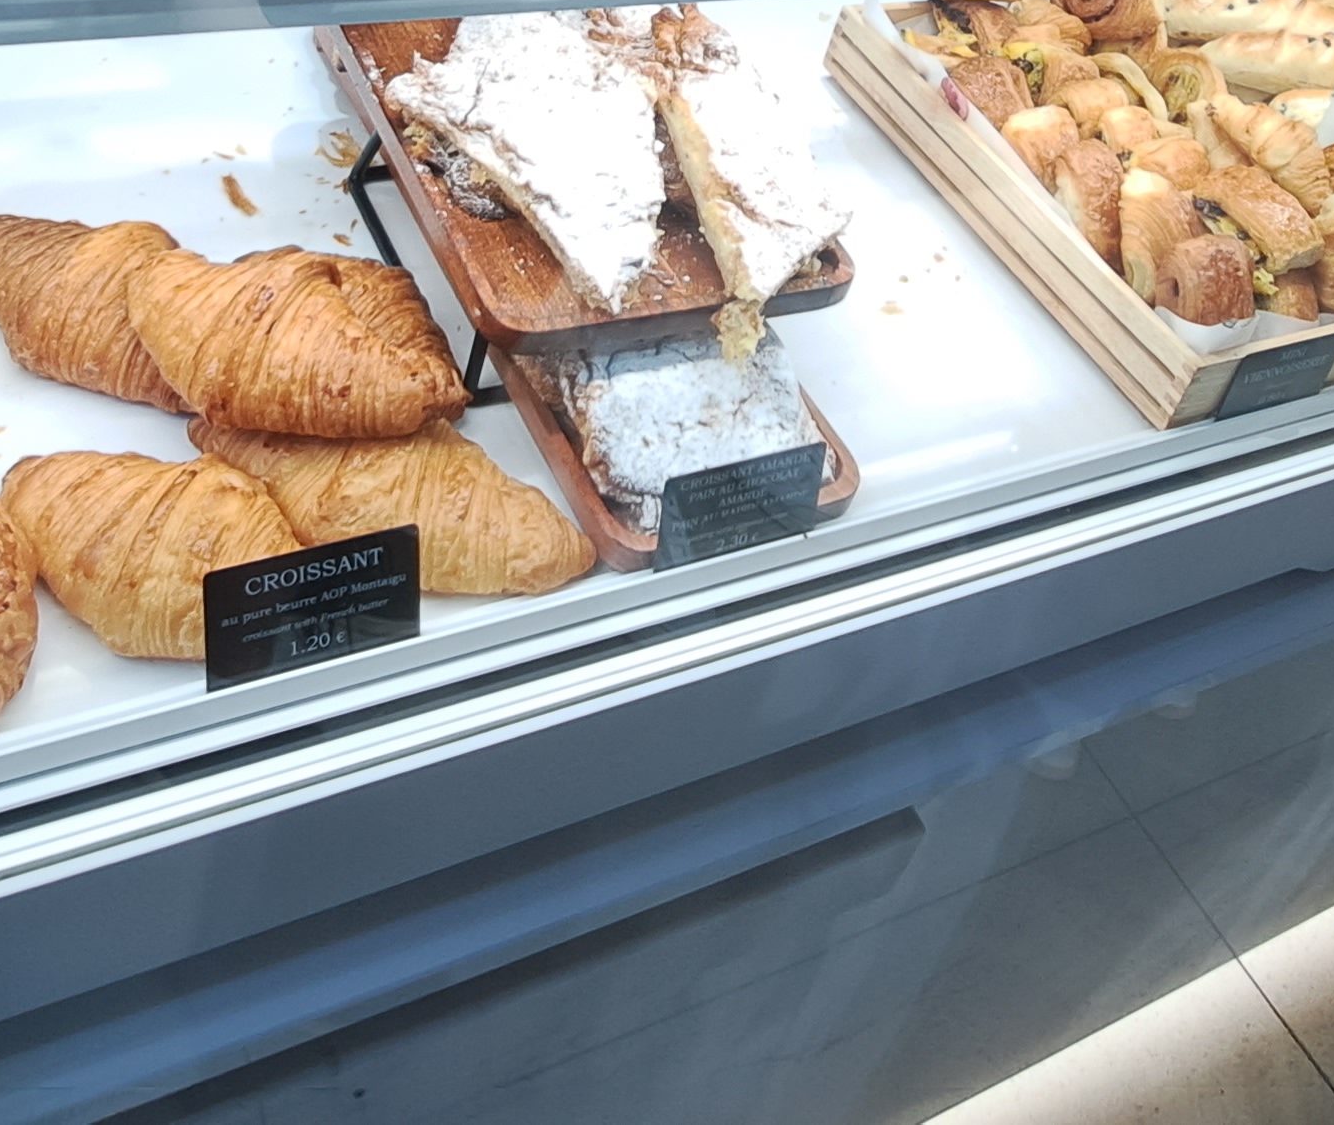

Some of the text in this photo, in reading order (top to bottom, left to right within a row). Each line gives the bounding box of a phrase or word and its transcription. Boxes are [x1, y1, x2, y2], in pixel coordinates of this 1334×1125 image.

[680, 465, 756, 492] CROISSANT
[245, 546, 384, 596] CROISSANT
[221, 573, 407, 627] au pure beurre AOP Montaigu
[242, 622, 292, 643] croissant
[290, 630, 346, 656] 1.20 €
